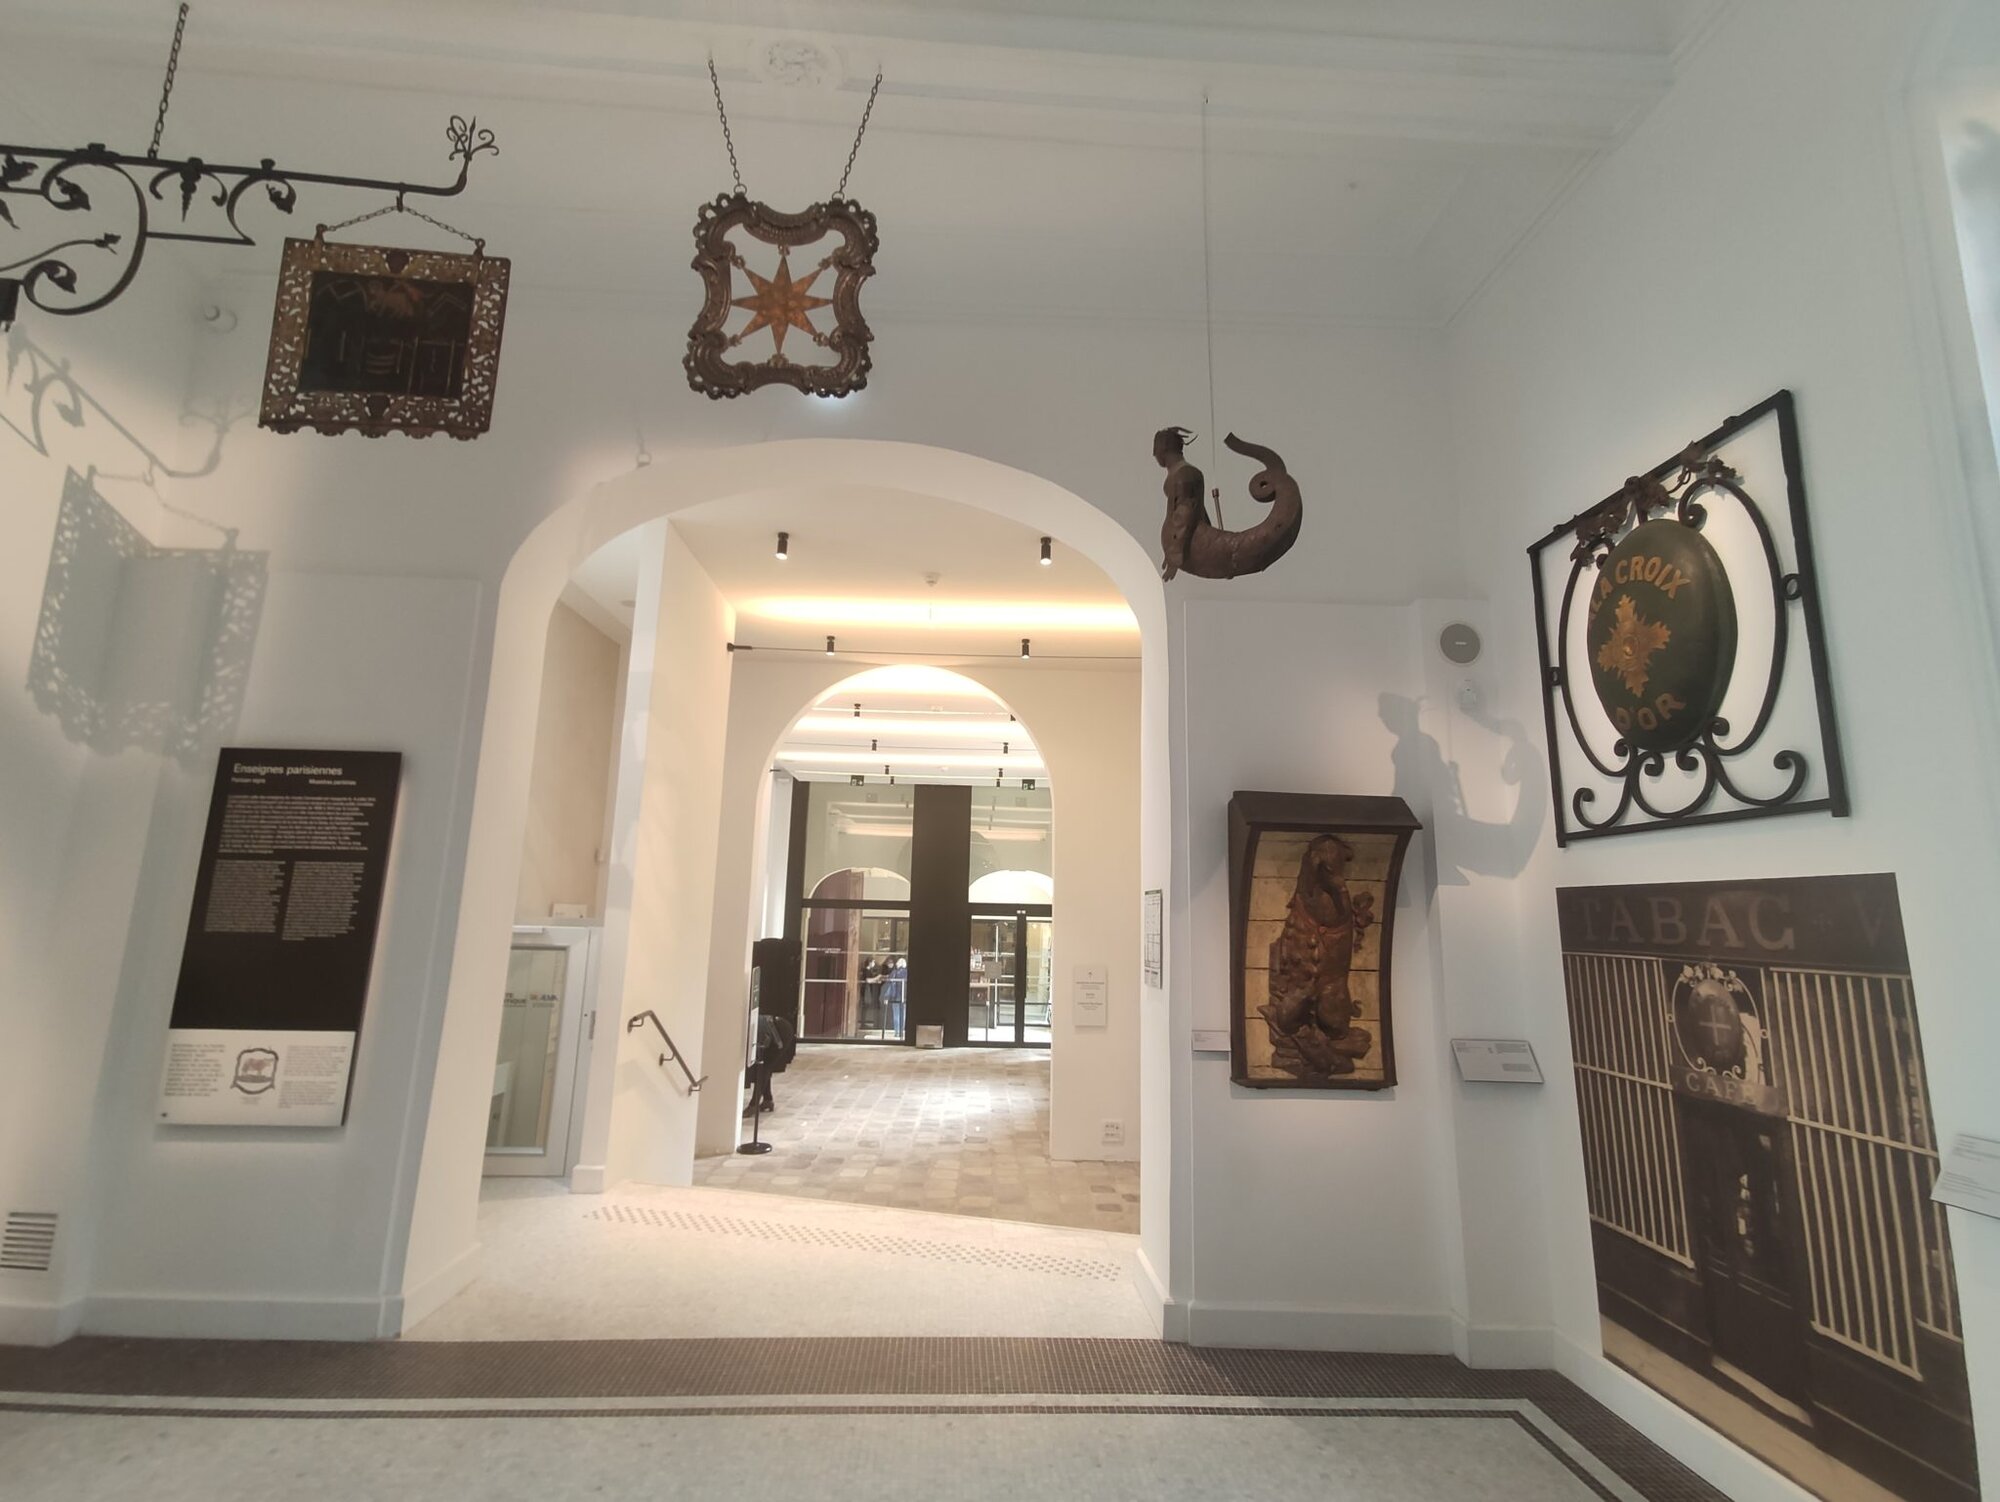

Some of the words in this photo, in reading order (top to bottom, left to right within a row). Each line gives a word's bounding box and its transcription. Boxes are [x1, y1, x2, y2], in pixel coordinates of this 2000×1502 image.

[1615, 555, 1691, 600] CROIX
[1615, 692, 1687, 731] D'OR
[233, 762, 284, 776] Enseignes
[286, 765, 343, 777] parisiennes
[1576, 890, 1796, 952] TABAC
